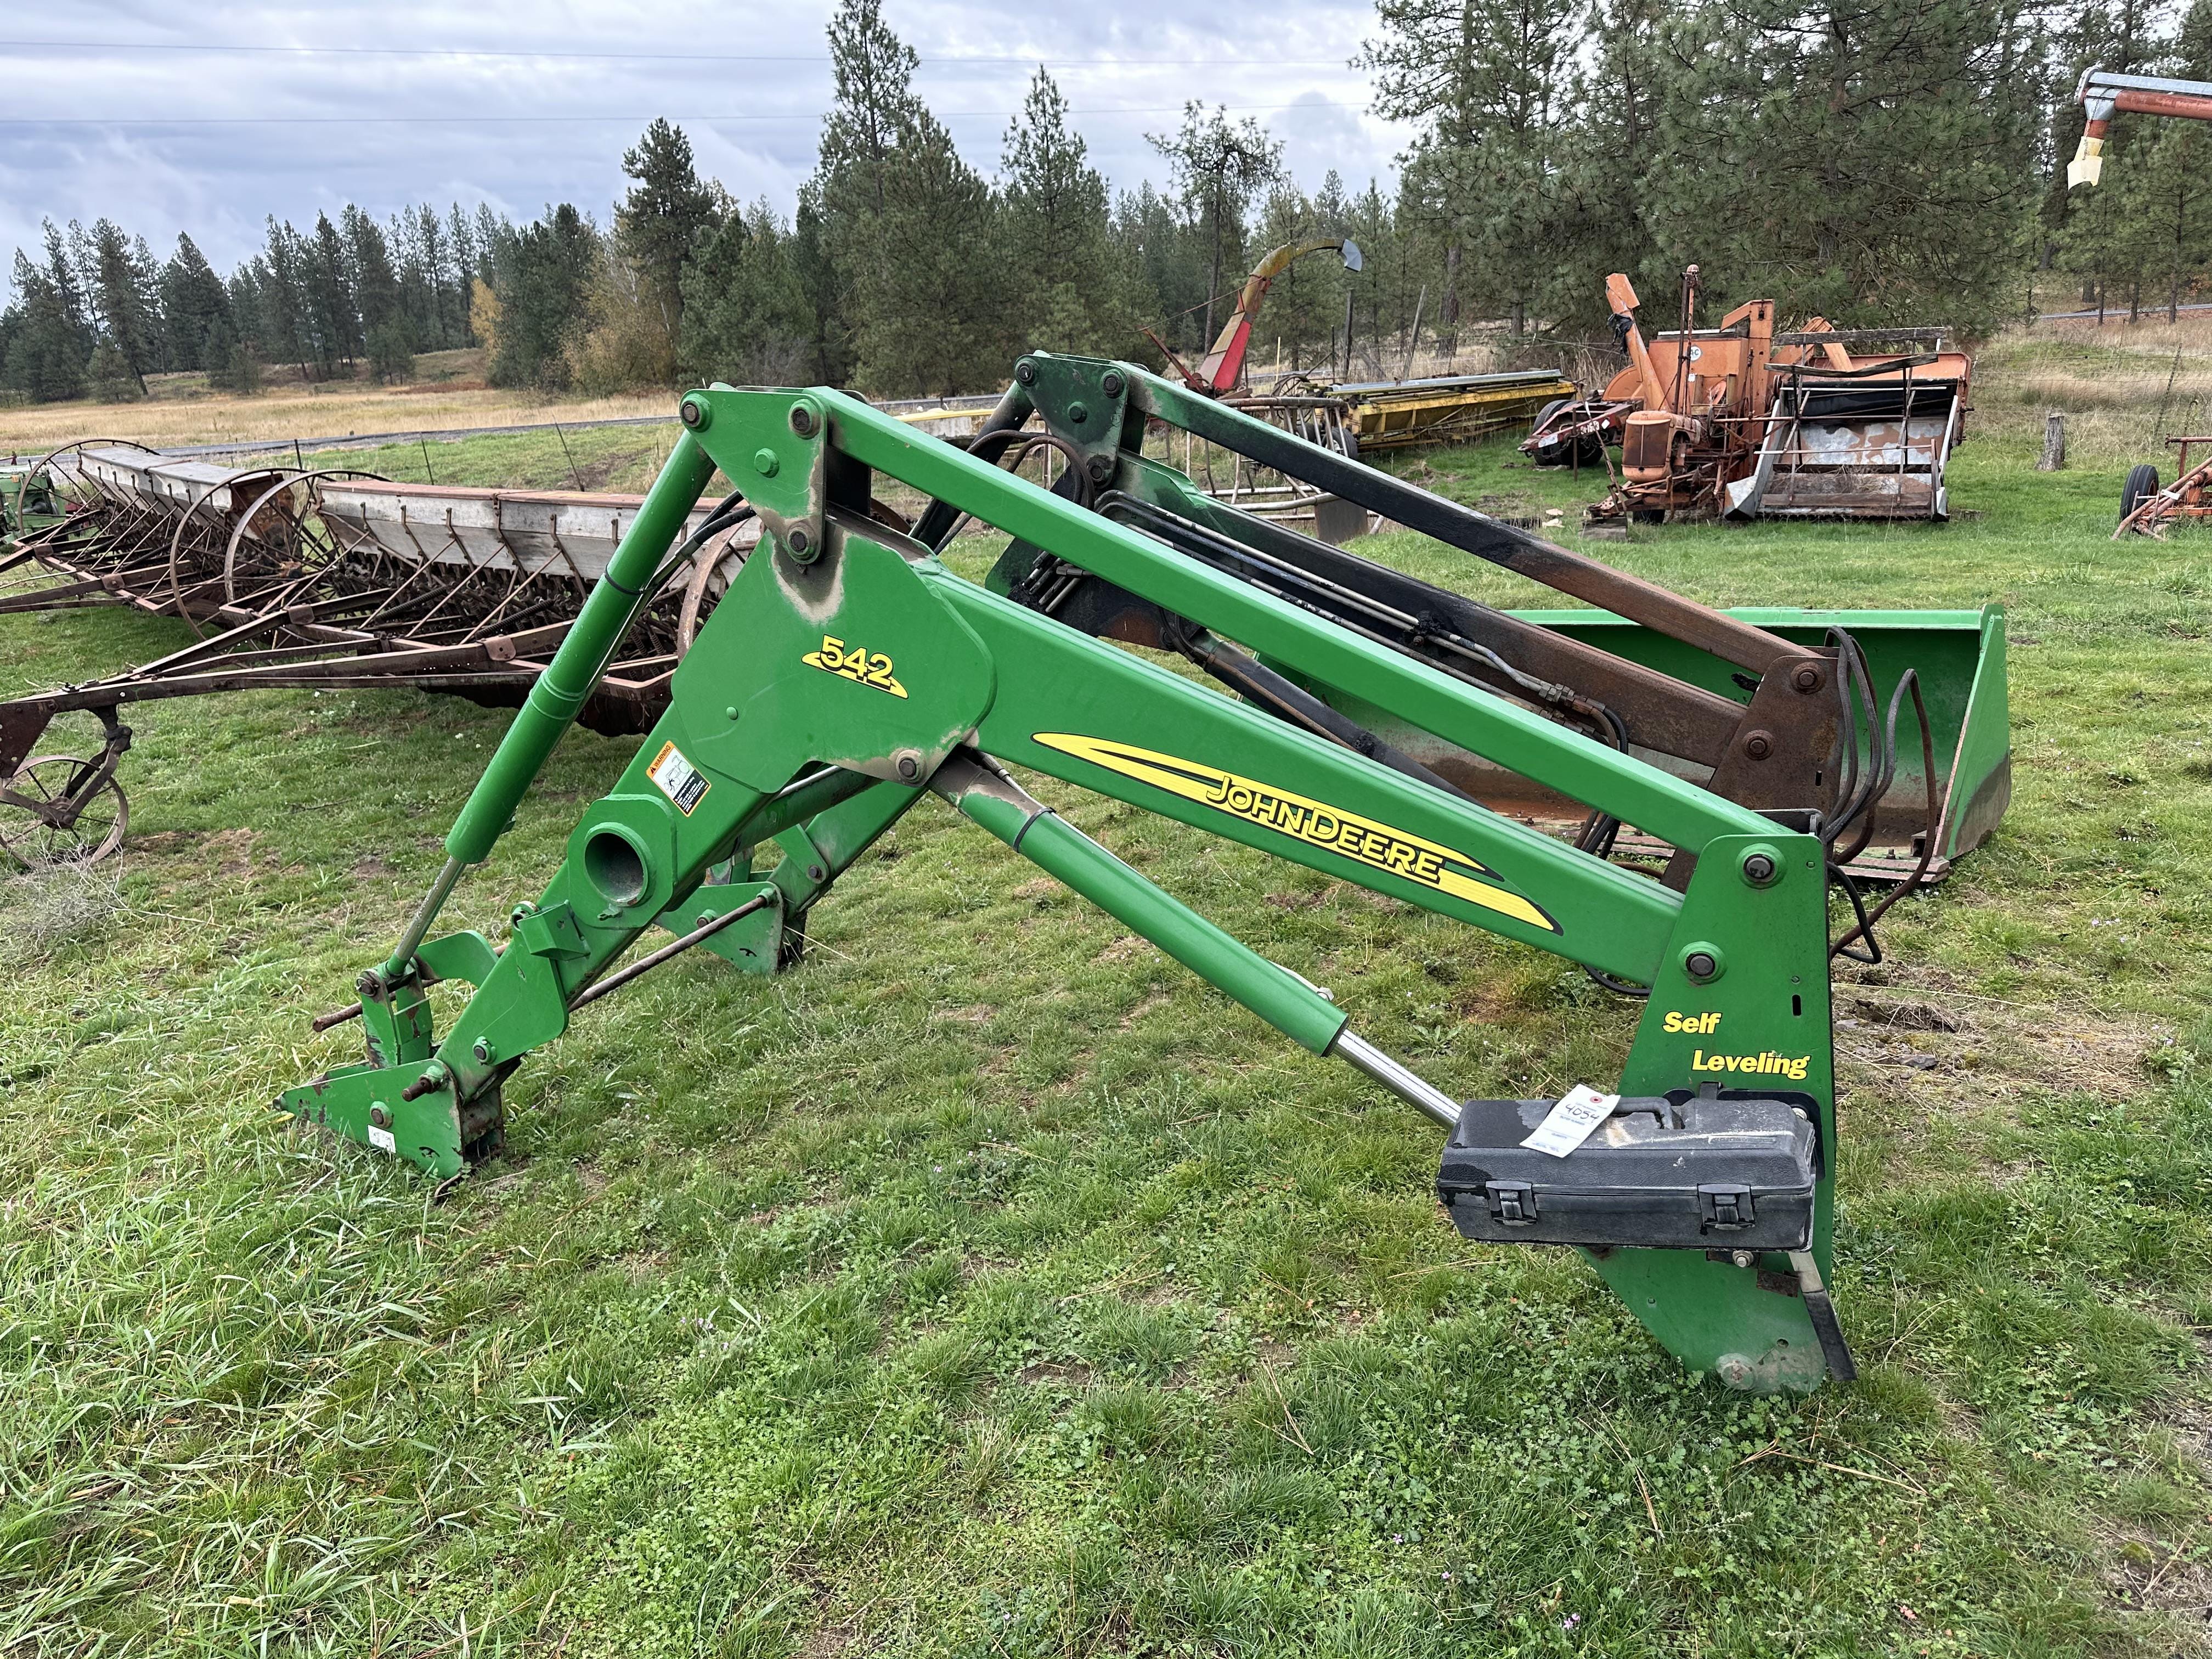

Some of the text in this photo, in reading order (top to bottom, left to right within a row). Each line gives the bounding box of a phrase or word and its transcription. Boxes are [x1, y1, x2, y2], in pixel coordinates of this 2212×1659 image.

[820, 634, 894, 690] 542
[654, 744, 672, 767] WARNING
[1206, 775, 1443, 884] JOHN DEERE
[1662, 1011, 1723, 1034] Self
[1691, 1049, 1812, 1080] Leveling
[1565, 1104, 1600, 1123] 4054
